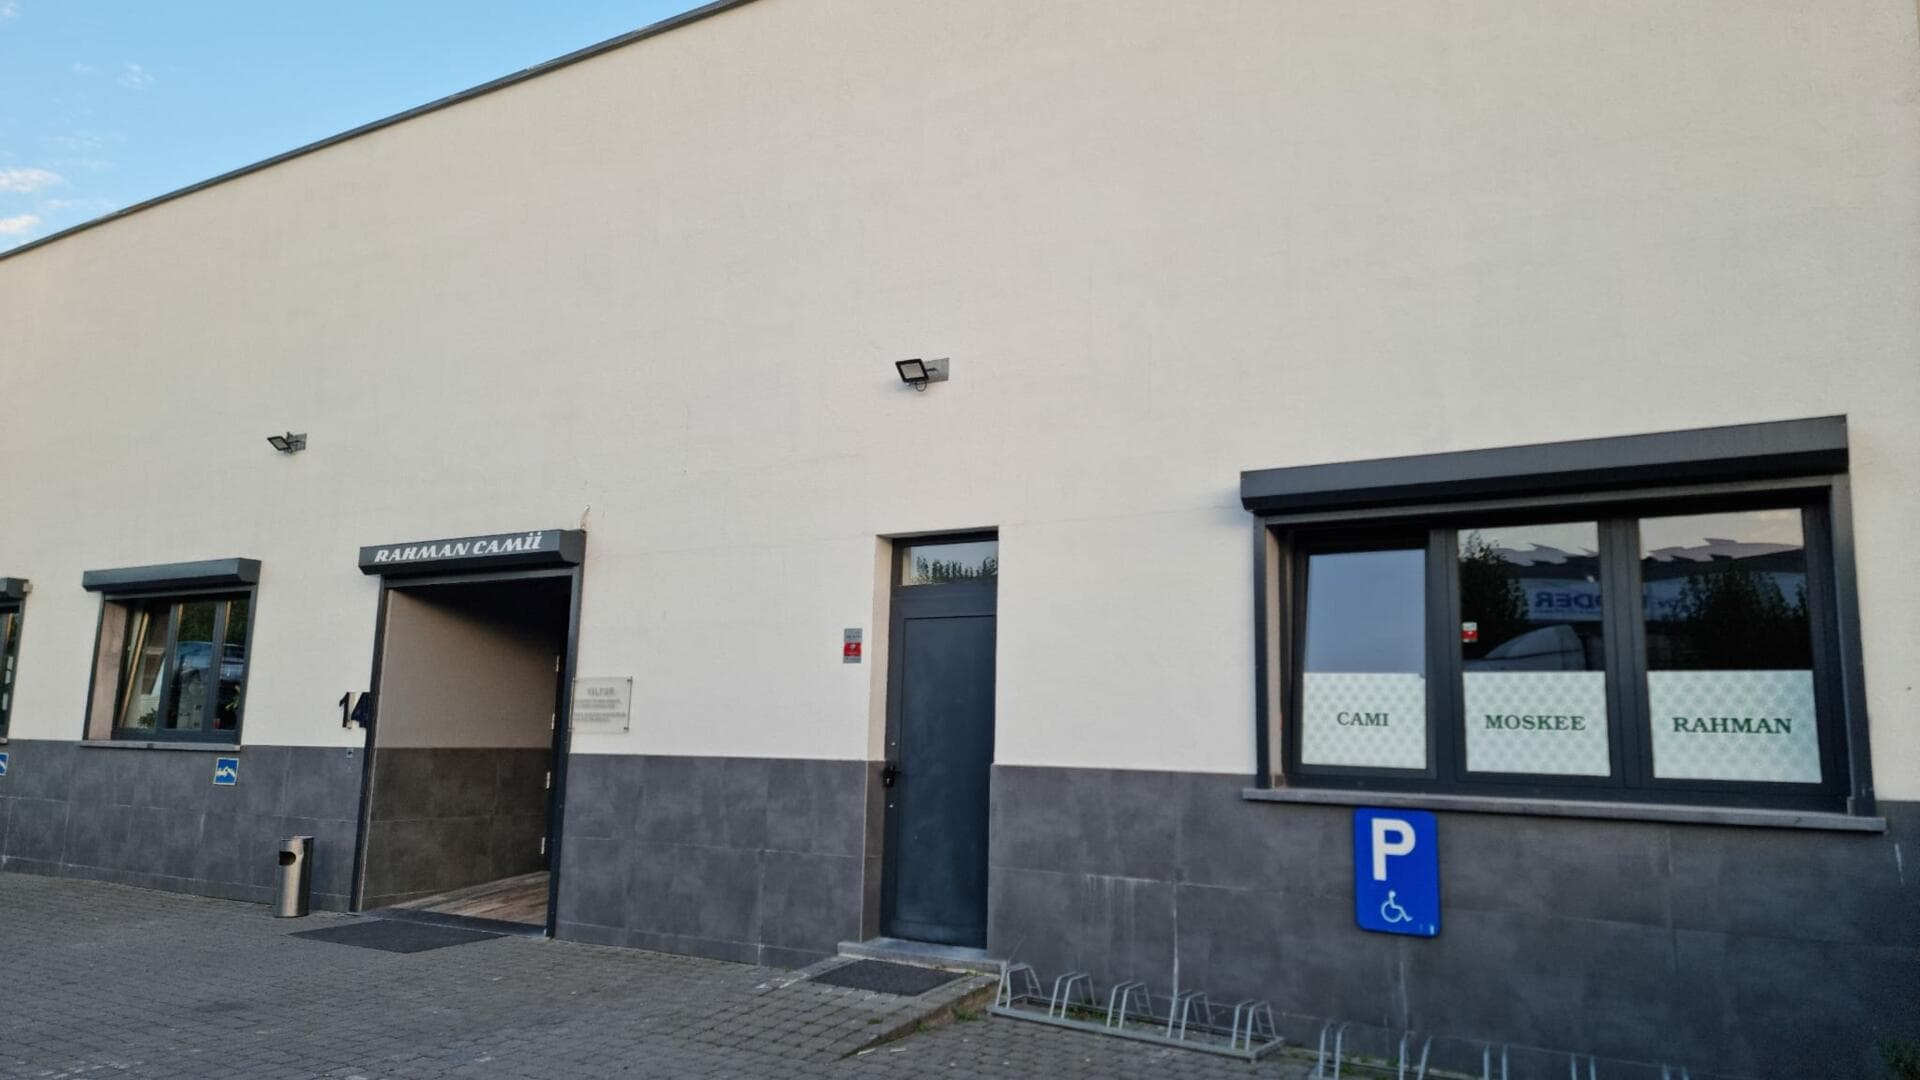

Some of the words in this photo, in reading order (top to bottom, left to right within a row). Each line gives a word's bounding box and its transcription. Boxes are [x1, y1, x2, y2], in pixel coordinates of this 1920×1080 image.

[374, 542, 470, 563] RAHMAN
[339, 691, 371, 728] 14
[1336, 711, 1390, 727] CAMI
[1484, 714, 1587, 731] MOSKEE
[1672, 716, 1793, 734] RAHMAN
[1371, 817, 1416, 881] P
